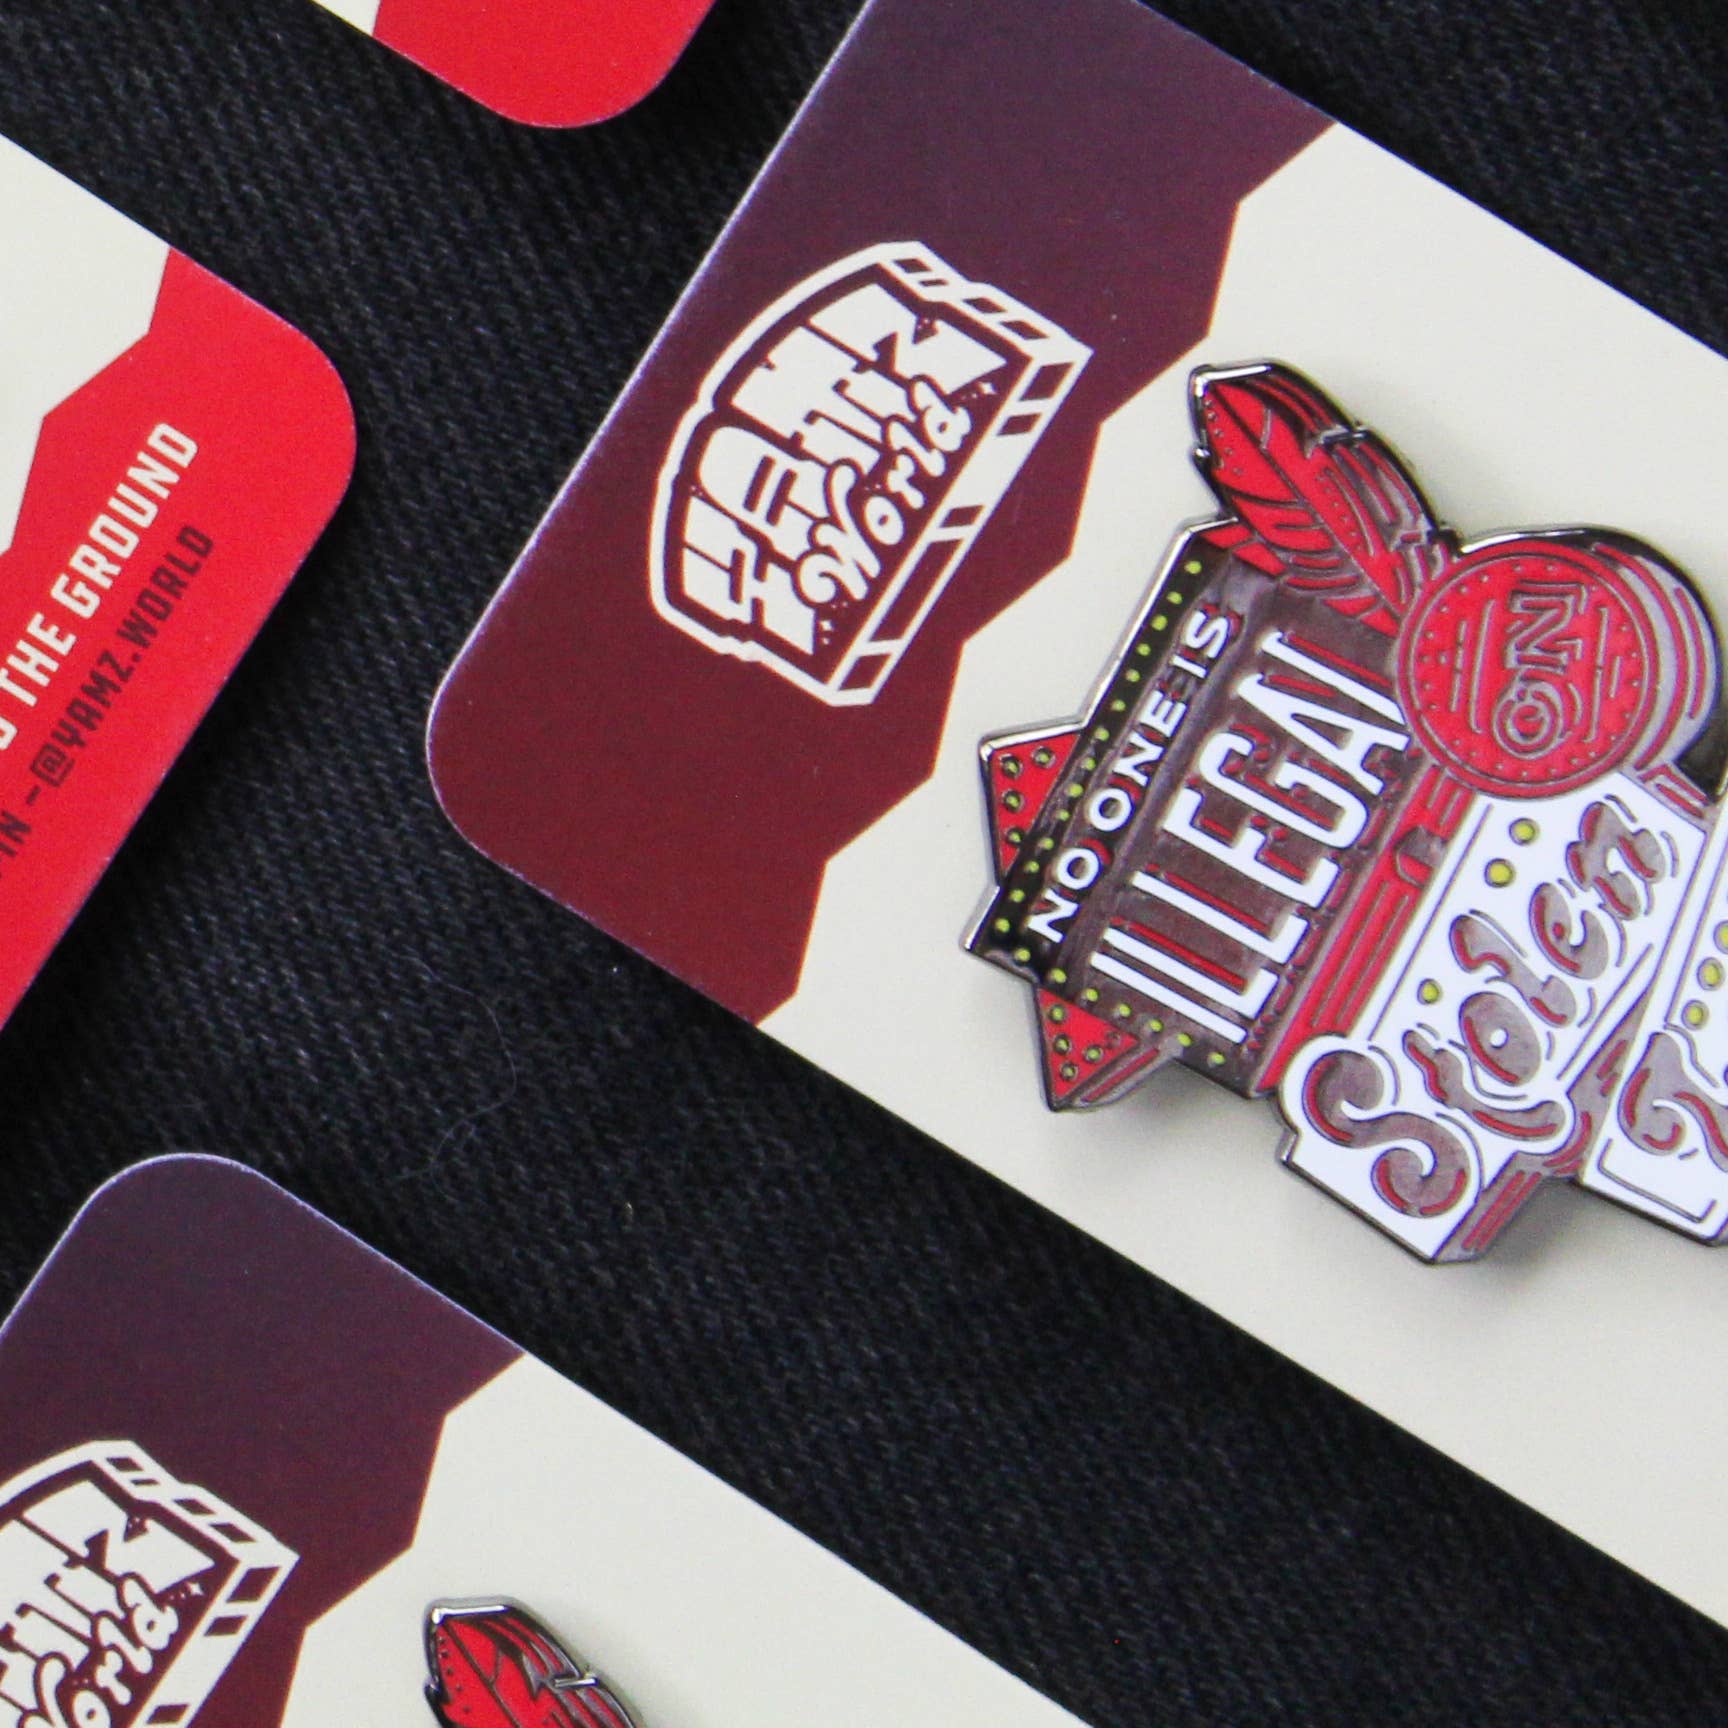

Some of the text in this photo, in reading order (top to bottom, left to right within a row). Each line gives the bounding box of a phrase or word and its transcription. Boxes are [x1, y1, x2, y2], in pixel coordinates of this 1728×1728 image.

[51, 424, 196, 617] GROUND
[798, 379, 971, 602] World
[1025, 608, 1228, 944] NO ONE IS
[1492, 589, 1572, 757] ON
[1303, 801, 1664, 1217] Stolen
